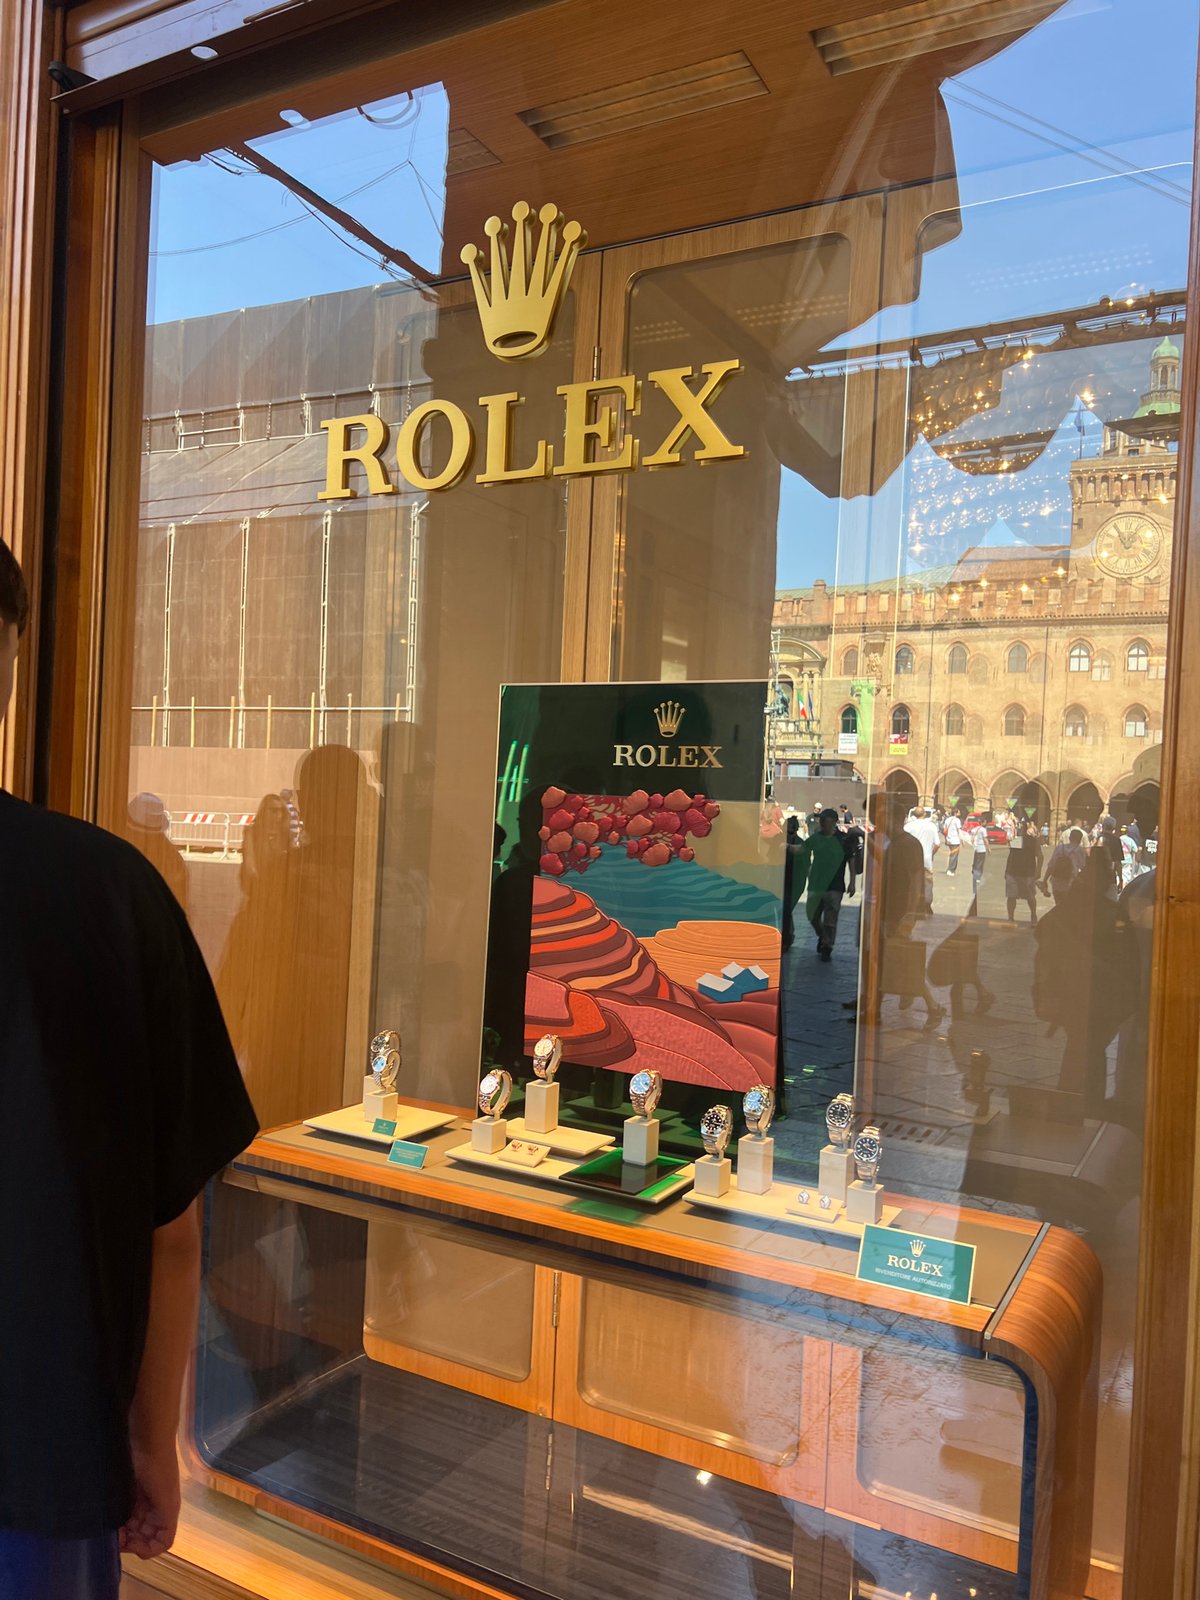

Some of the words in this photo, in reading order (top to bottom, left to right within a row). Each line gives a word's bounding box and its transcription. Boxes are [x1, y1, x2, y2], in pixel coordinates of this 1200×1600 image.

[317, 358, 749, 501] ROLEX
[612, 744, 723, 768] ROLEX
[886, 1254, 944, 1277] ROLEX
